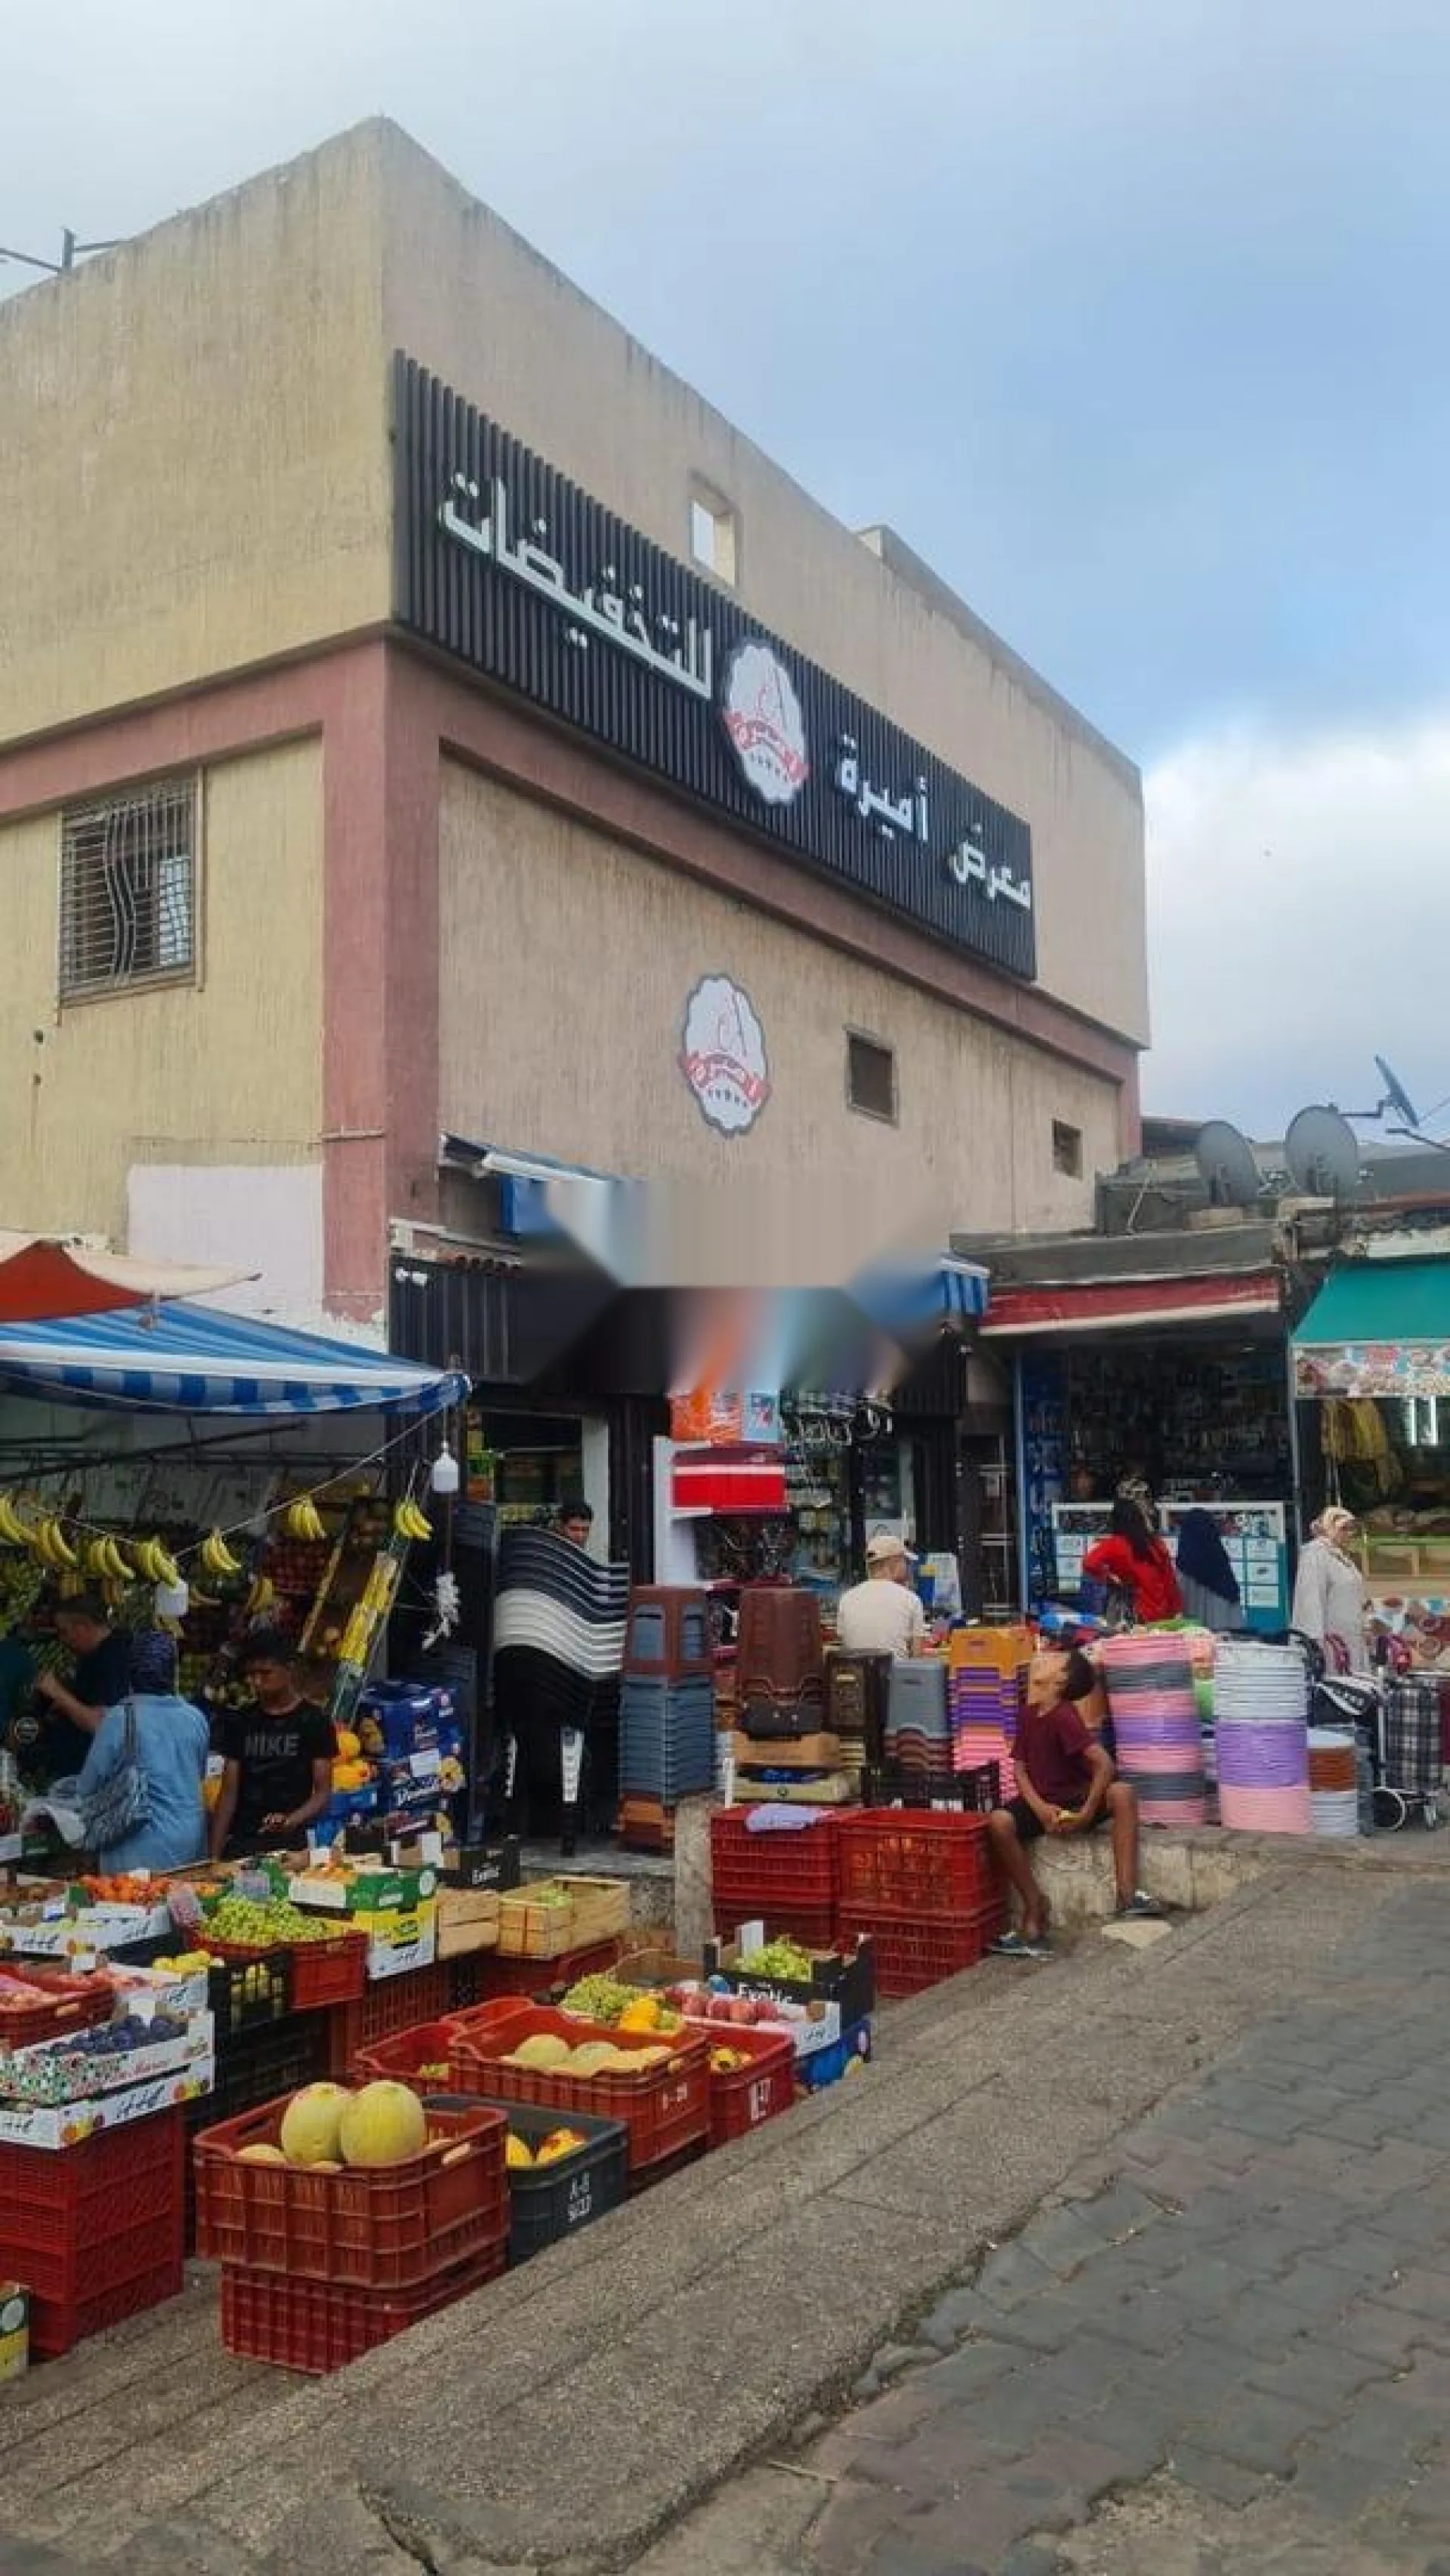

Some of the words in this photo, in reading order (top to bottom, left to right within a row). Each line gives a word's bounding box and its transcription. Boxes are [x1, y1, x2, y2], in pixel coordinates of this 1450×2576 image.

[438, 472, 711, 699] للتخفيضات
[835, 734, 927, 842] أميرة
[949, 823, 1031, 909] معرض
[245, 1732, 301, 1757] NIKE
